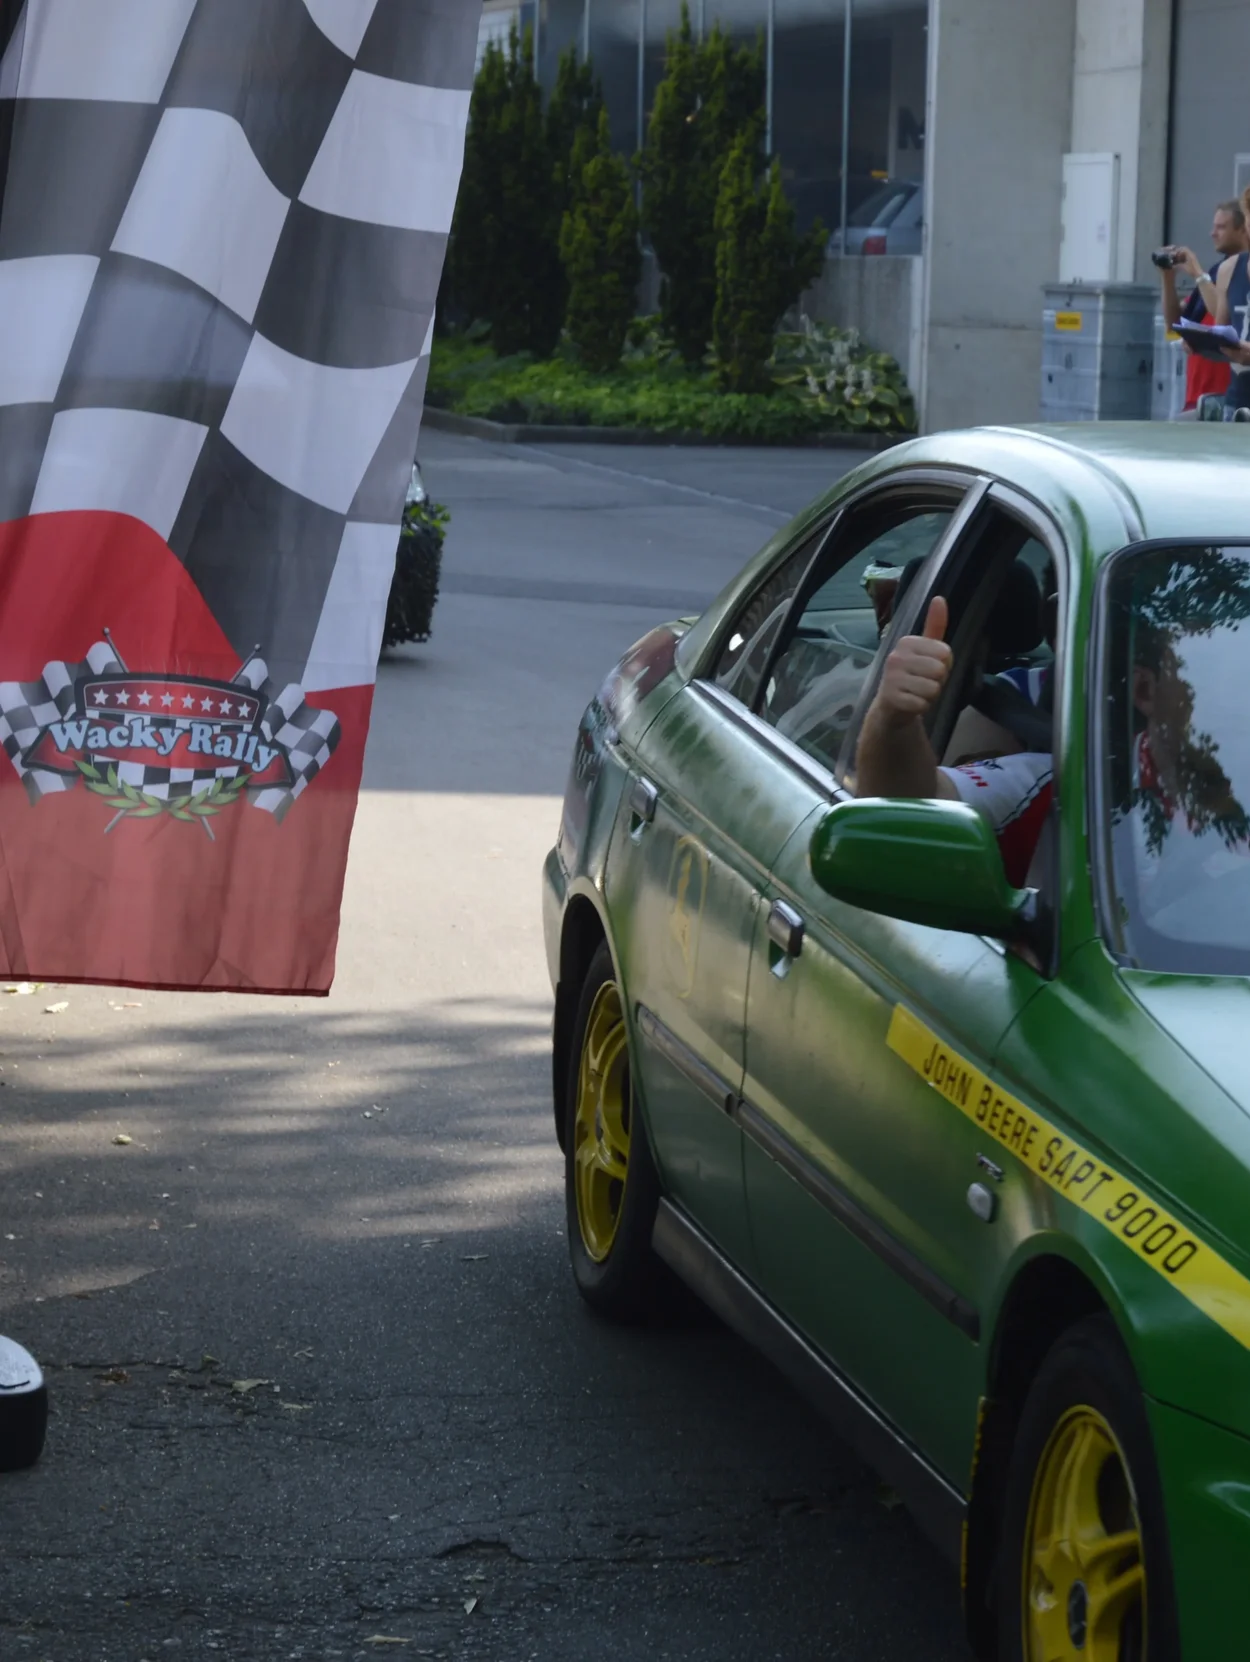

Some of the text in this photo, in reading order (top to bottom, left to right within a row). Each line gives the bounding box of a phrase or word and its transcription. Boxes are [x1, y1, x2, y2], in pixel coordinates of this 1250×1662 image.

[49, 716, 281, 773] Wacky Rally
[923, 1042, 1198, 1274] JOHN BEERE SAPT 9000
